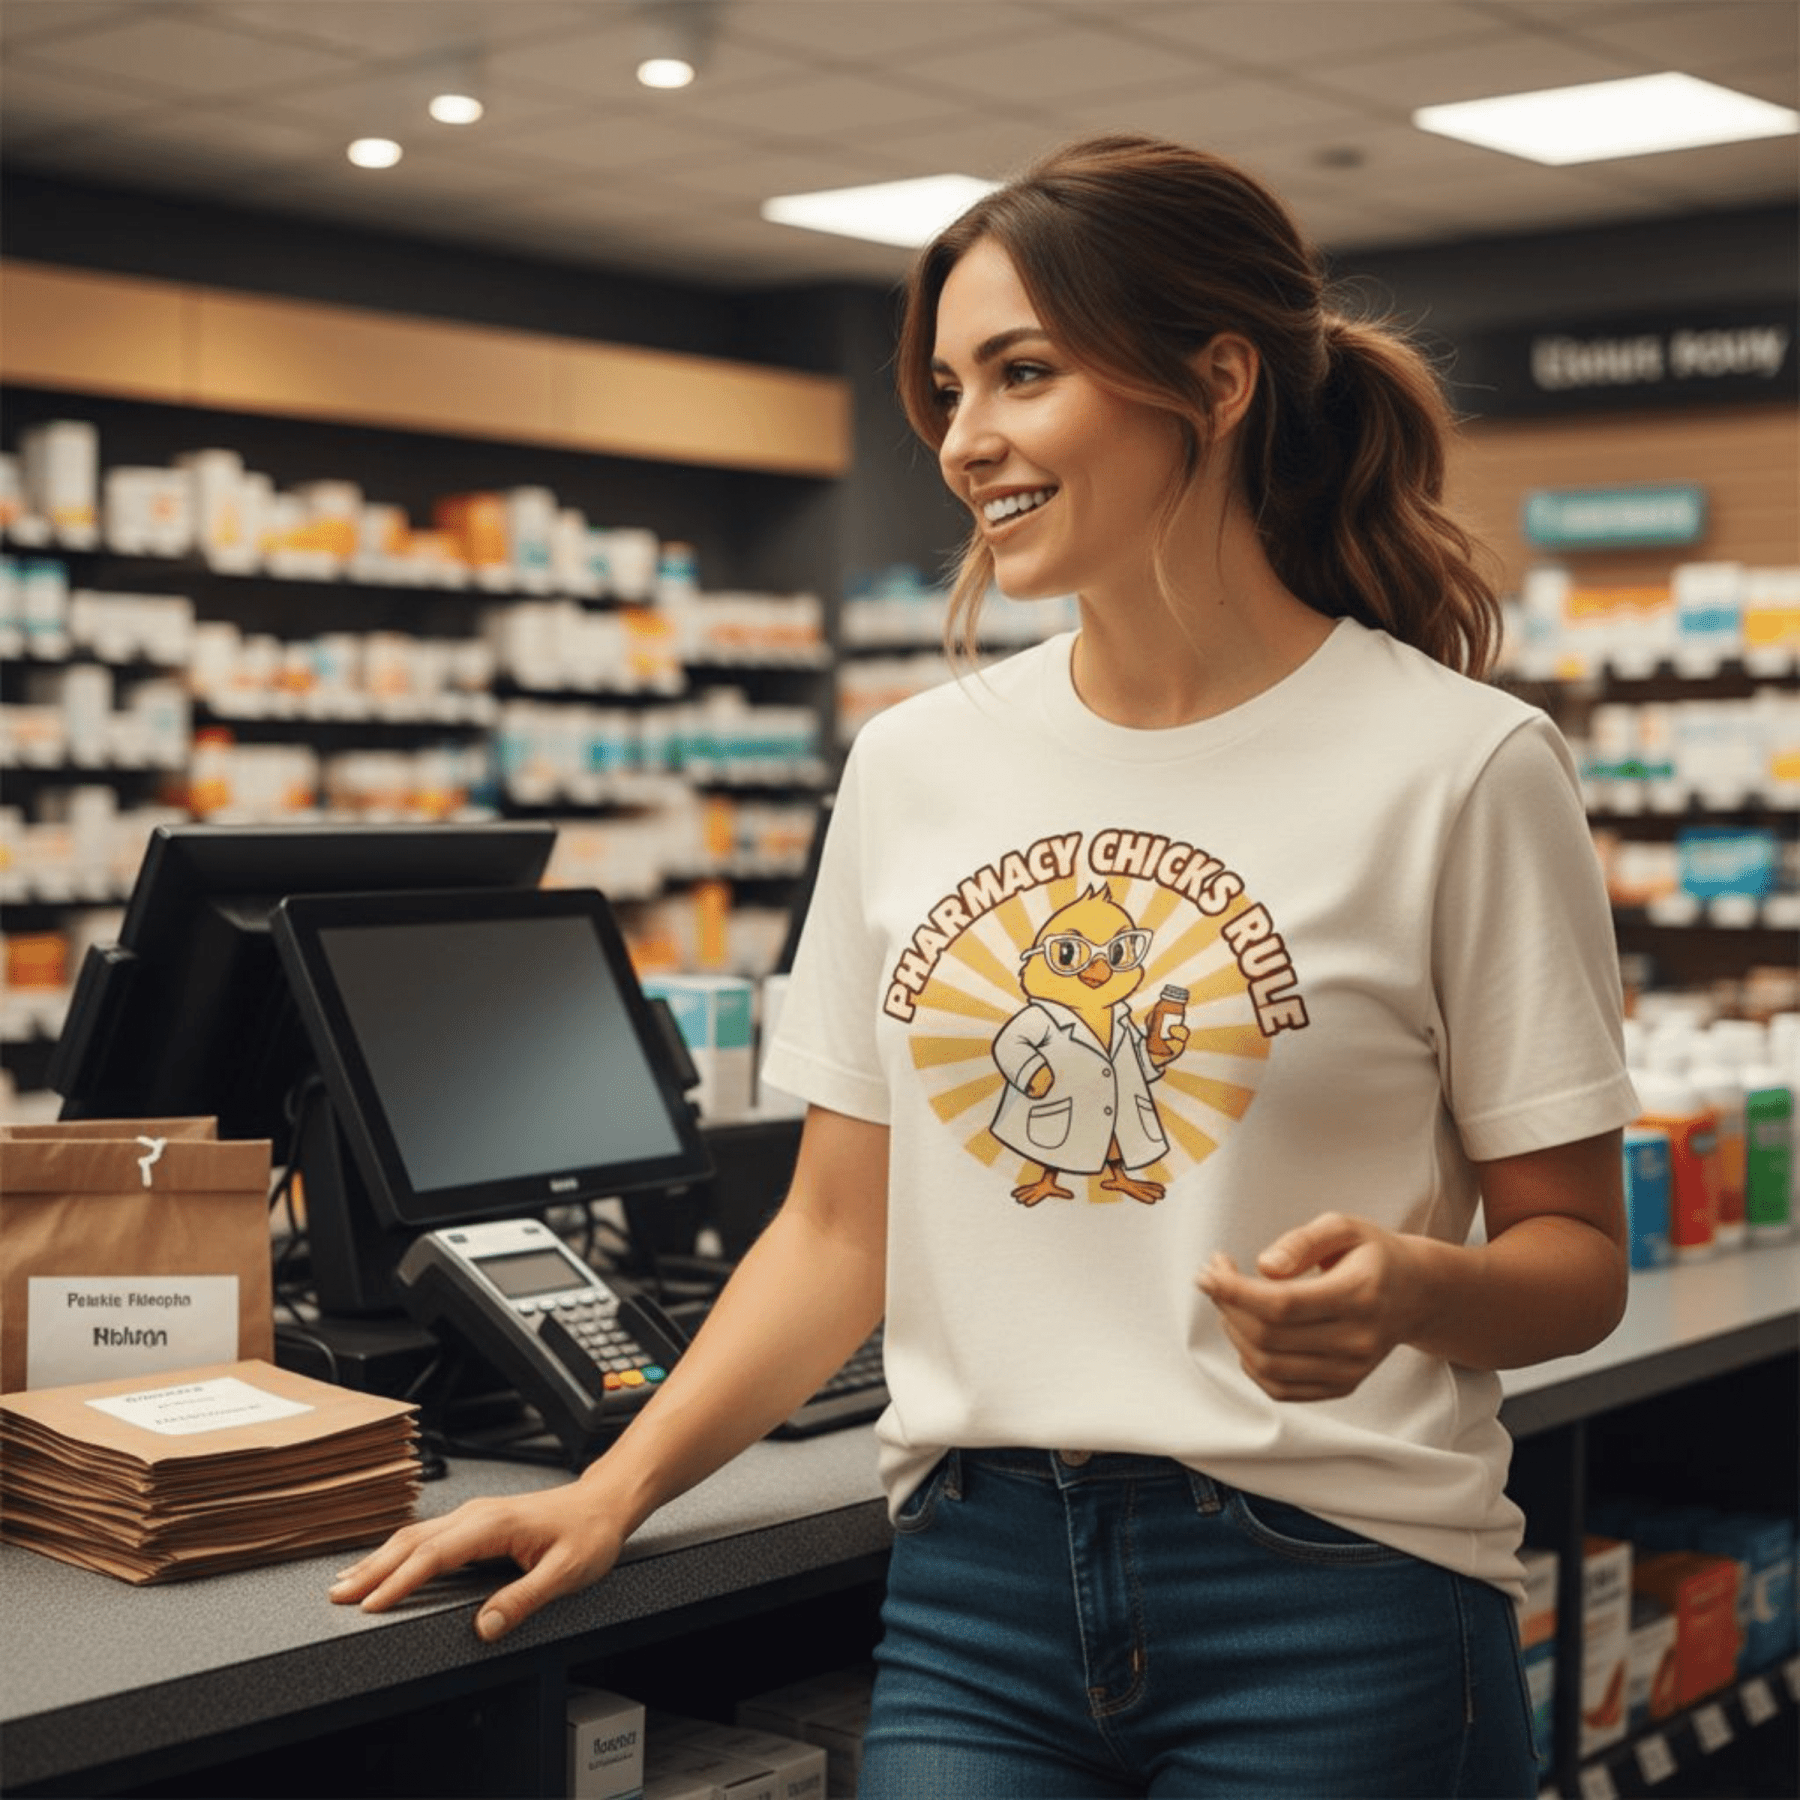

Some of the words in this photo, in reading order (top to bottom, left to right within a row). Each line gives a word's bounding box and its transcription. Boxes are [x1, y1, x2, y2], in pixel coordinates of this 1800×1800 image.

[883, 832, 1082, 1023] PHARMACY
[1088, 829, 1245, 916] CHICKS
[1221, 903, 1309, 1037] RULE
